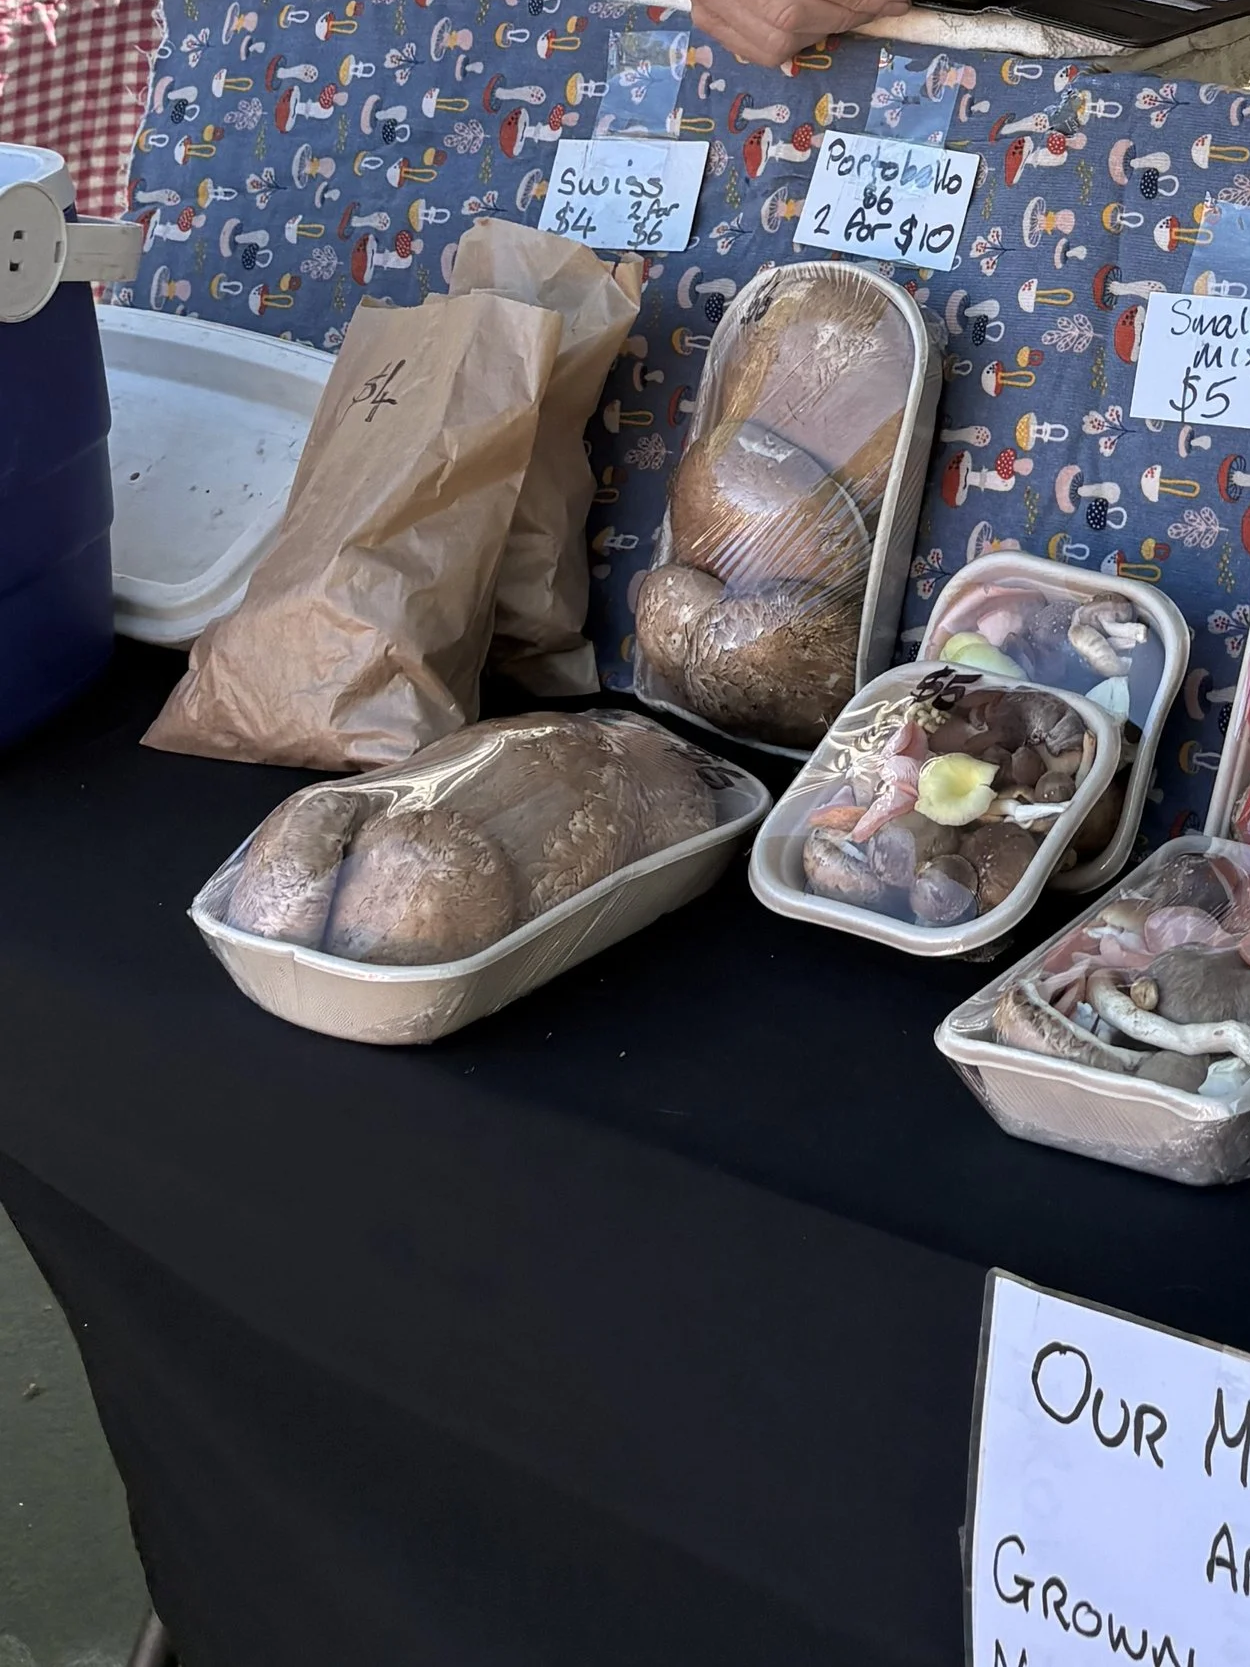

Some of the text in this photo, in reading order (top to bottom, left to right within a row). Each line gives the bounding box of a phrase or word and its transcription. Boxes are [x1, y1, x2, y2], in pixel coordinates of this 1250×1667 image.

[547, 204, 597, 238] $4
[862, 185, 894, 216] $6
[813, 203, 831, 236] 2
[894, 213, 955, 256] $10
[1168, 366, 1238, 424] $5
[1031, 1340, 1169, 1468] OUR
[993, 1534, 1197, 1667] GROWN
